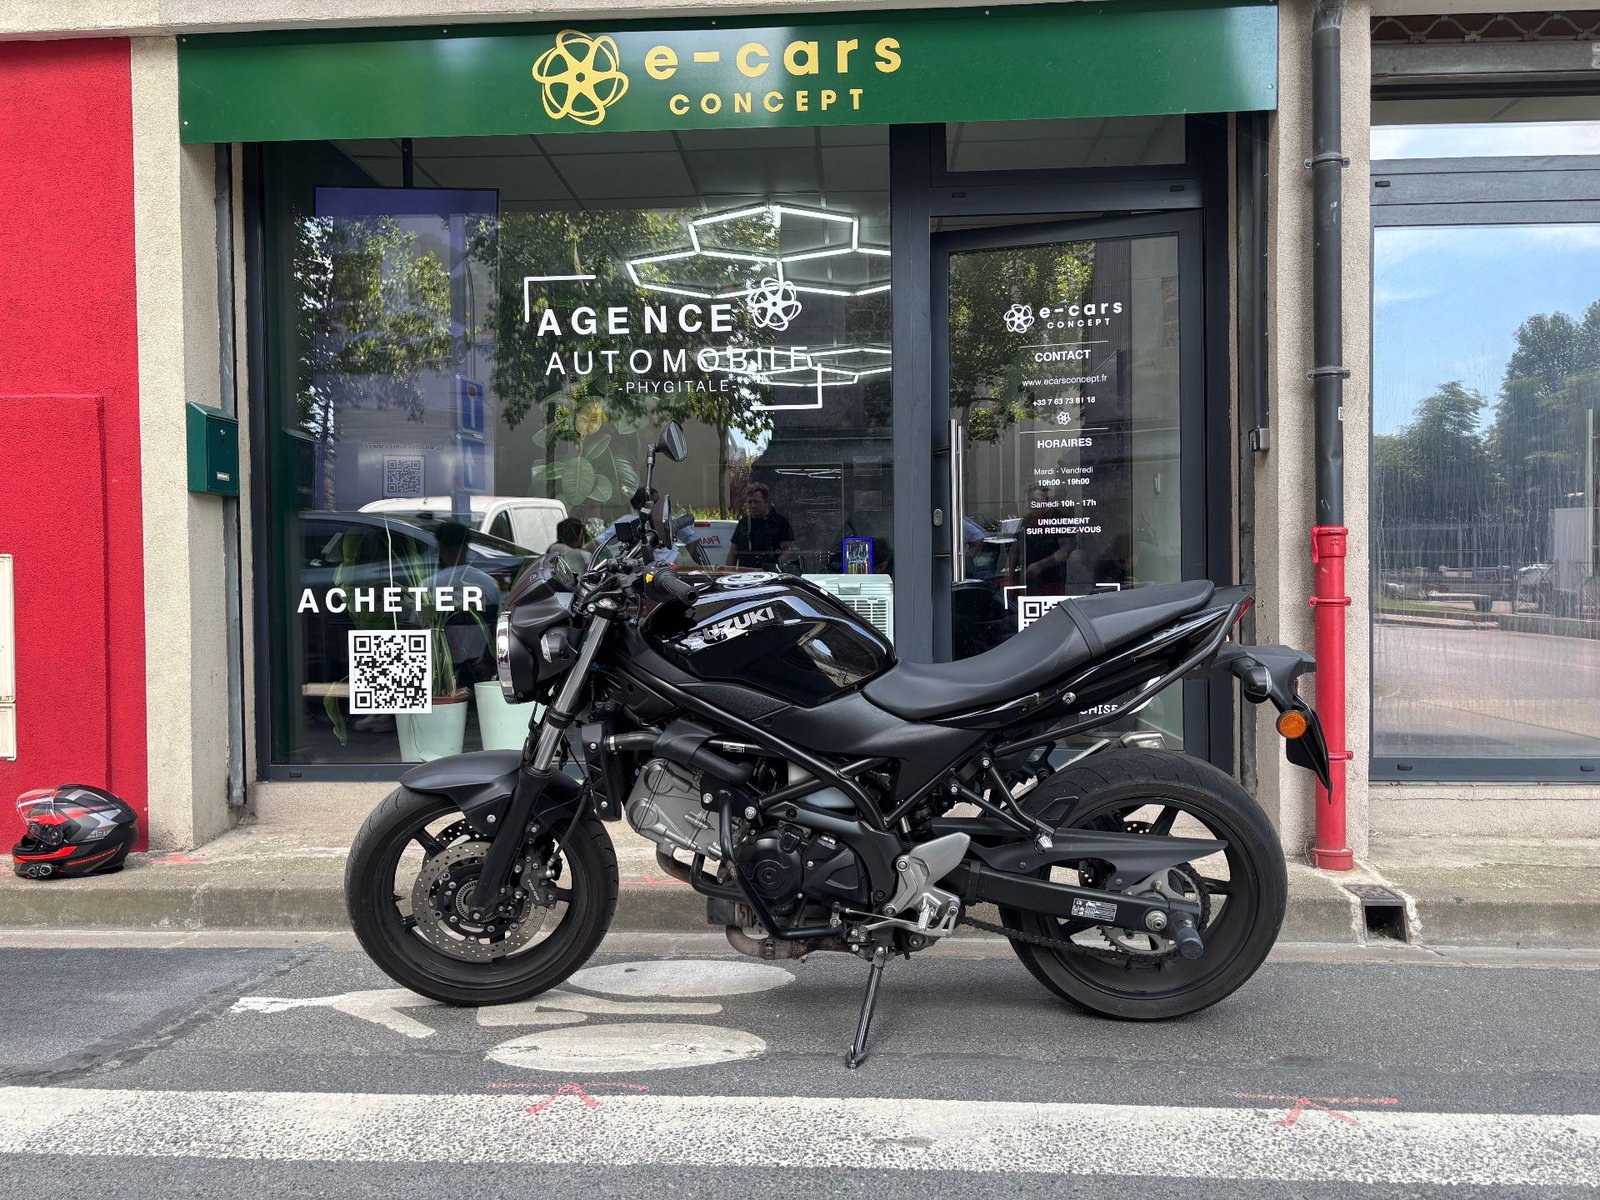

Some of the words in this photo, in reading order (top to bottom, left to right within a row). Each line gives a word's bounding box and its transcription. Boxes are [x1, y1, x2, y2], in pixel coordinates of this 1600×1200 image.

[644, 37, 902, 80] e-cars
[669, 89, 864, 115] CONCEPT
[1039, 301, 1122, 318] e-cars
[537, 304, 733, 337] AGENCE
[1047, 317, 1110, 328] CONCEPT
[545, 346, 808, 376] AUTOMOBILE
[1034, 350, 1091, 362] CONTACT
[1022, 374, 1107, 386] www.ecarsconcept.fr
[1086, 396, 1096, 404] 18
[1037, 438, 1093, 449] HORAIRES
[1060, 466, 1094, 474] Vendredi
[1030, 501, 1059, 509] Samedi
[1037, 517, 1090, 525] UNIQUEMENT
[1044, 526, 1102, 534] RENDEZ-VOUS
[297, 586, 484, 613] ACHETER
[681, 607, 775, 647] SUZUKI
